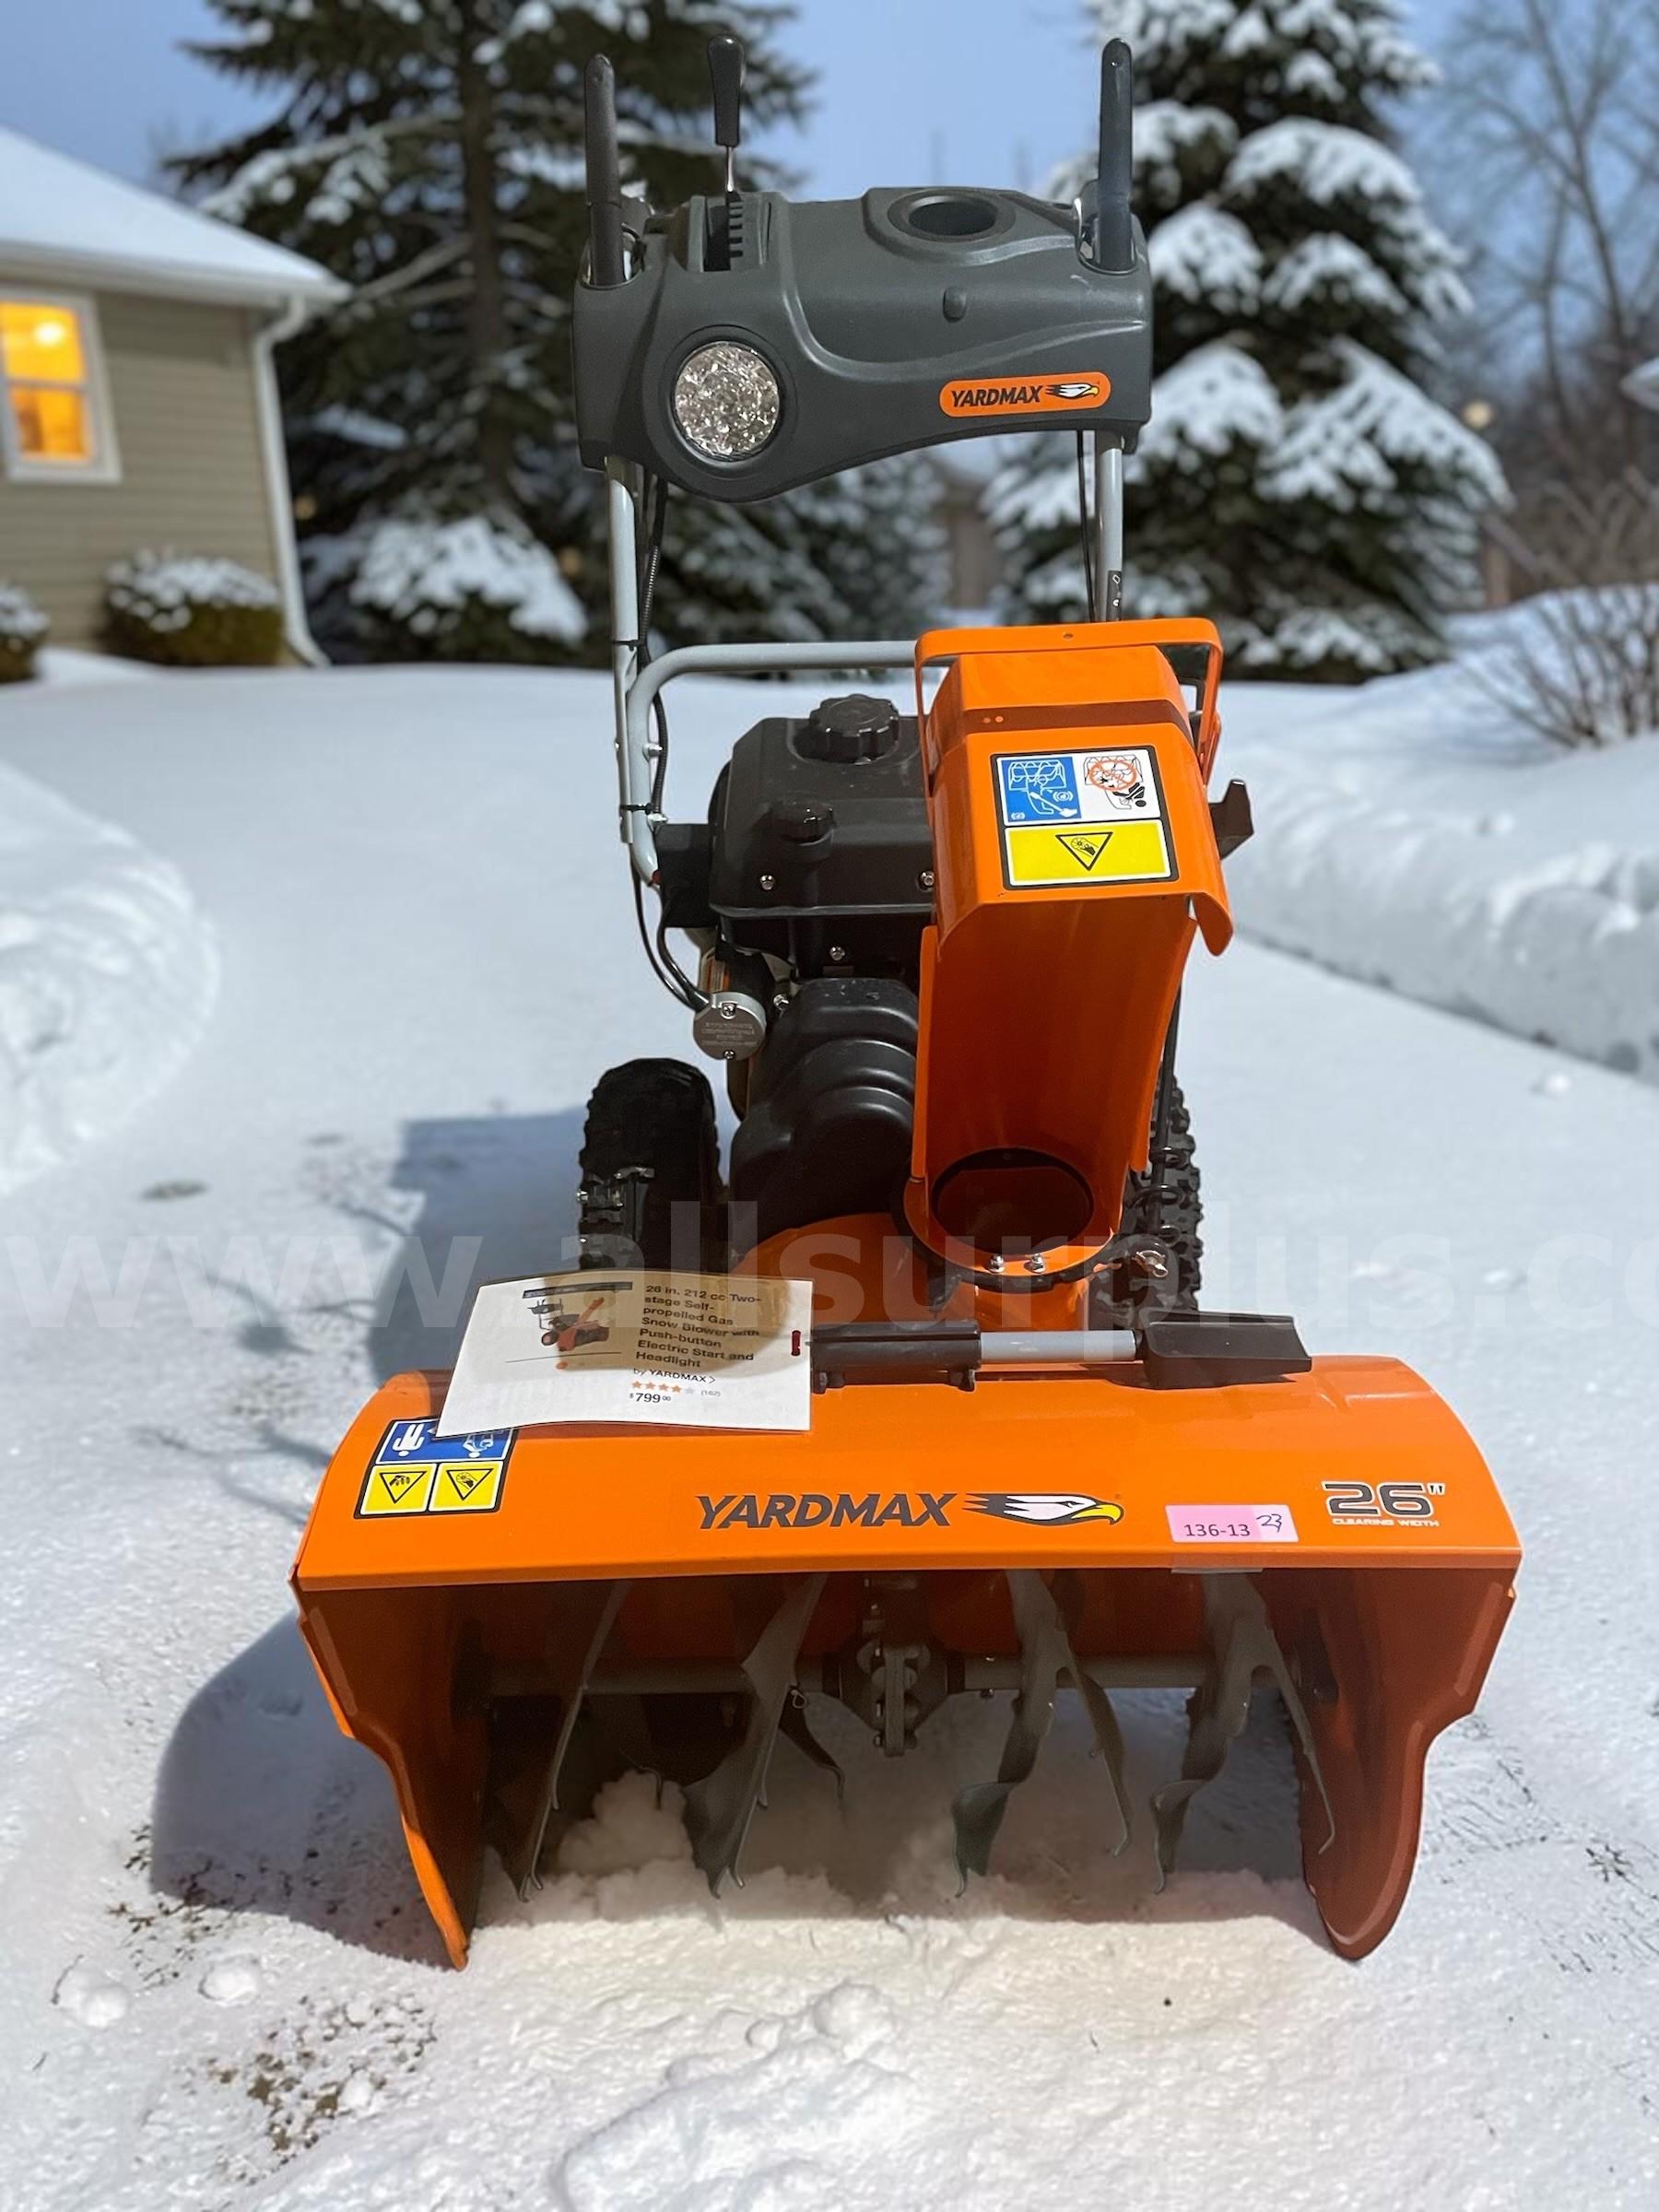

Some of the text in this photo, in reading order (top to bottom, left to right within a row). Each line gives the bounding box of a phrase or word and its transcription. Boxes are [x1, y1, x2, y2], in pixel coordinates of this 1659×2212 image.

[951, 385, 1043, 407] YARDMAX
[644, 1296, 715, 1311] stage Self-
[684, 1288, 707, 1300] 212
[710, 1293, 726, 1301] cc
[729, 1293, 762, 1302] Two-
[642, 1307, 734, 1325] propelled Gas
[641, 1317, 678, 1329] Snow
[682, 1323, 729, 1336] Blower
[640, 1328, 722, 1347] Push-button
[637, 1339, 754, 1360] Electric Start and
[635, 1351, 700, 1368] Headlight
[633, 1368, 707, 1383] by YARDMAX
[694, 1492, 959, 1530] YARDMAX
[1183, 1524, 1251, 1536] 136-13
[1332, 1518, 1440, 1527] CLEARING WIDTH
